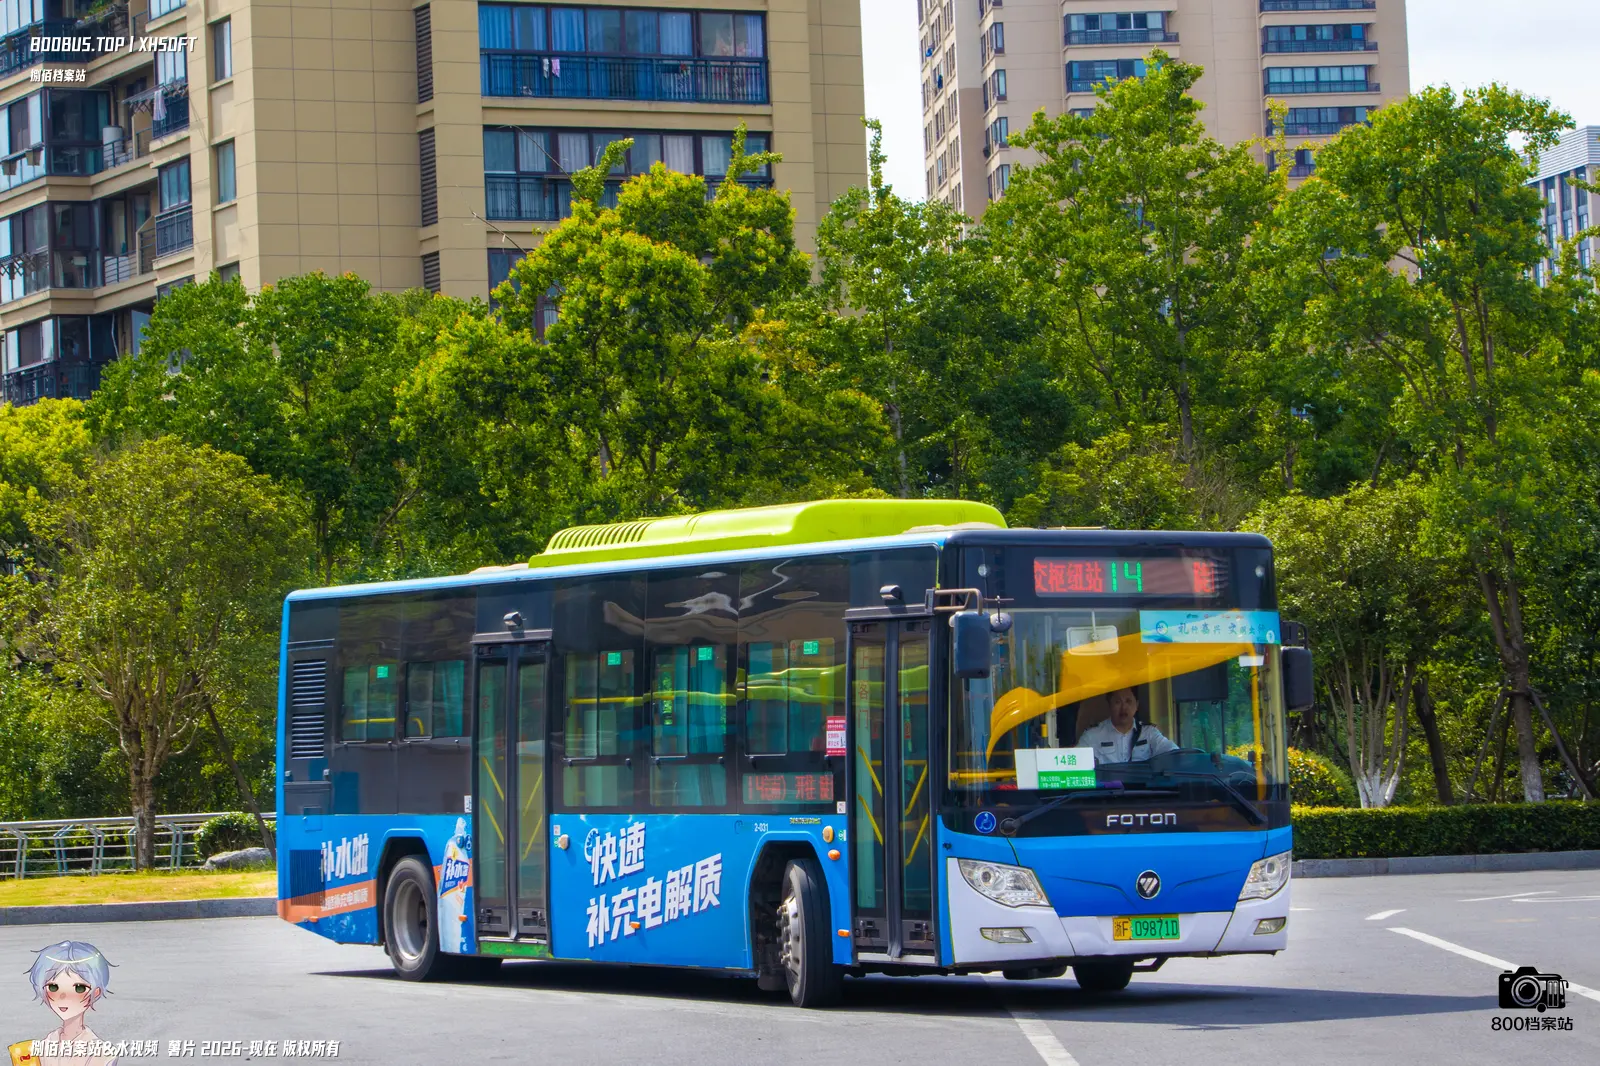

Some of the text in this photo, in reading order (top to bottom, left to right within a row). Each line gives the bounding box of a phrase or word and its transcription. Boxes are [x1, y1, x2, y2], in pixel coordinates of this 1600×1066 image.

[1111, 561, 1143, 593] 14
[1053, 754, 1077, 766] 14路
[1106, 812, 1177, 827] FOTON
[320, 832, 369, 883] 补水啦
[585, 821, 647, 886] 快速
[586, 853, 723, 948] 补充电解质
